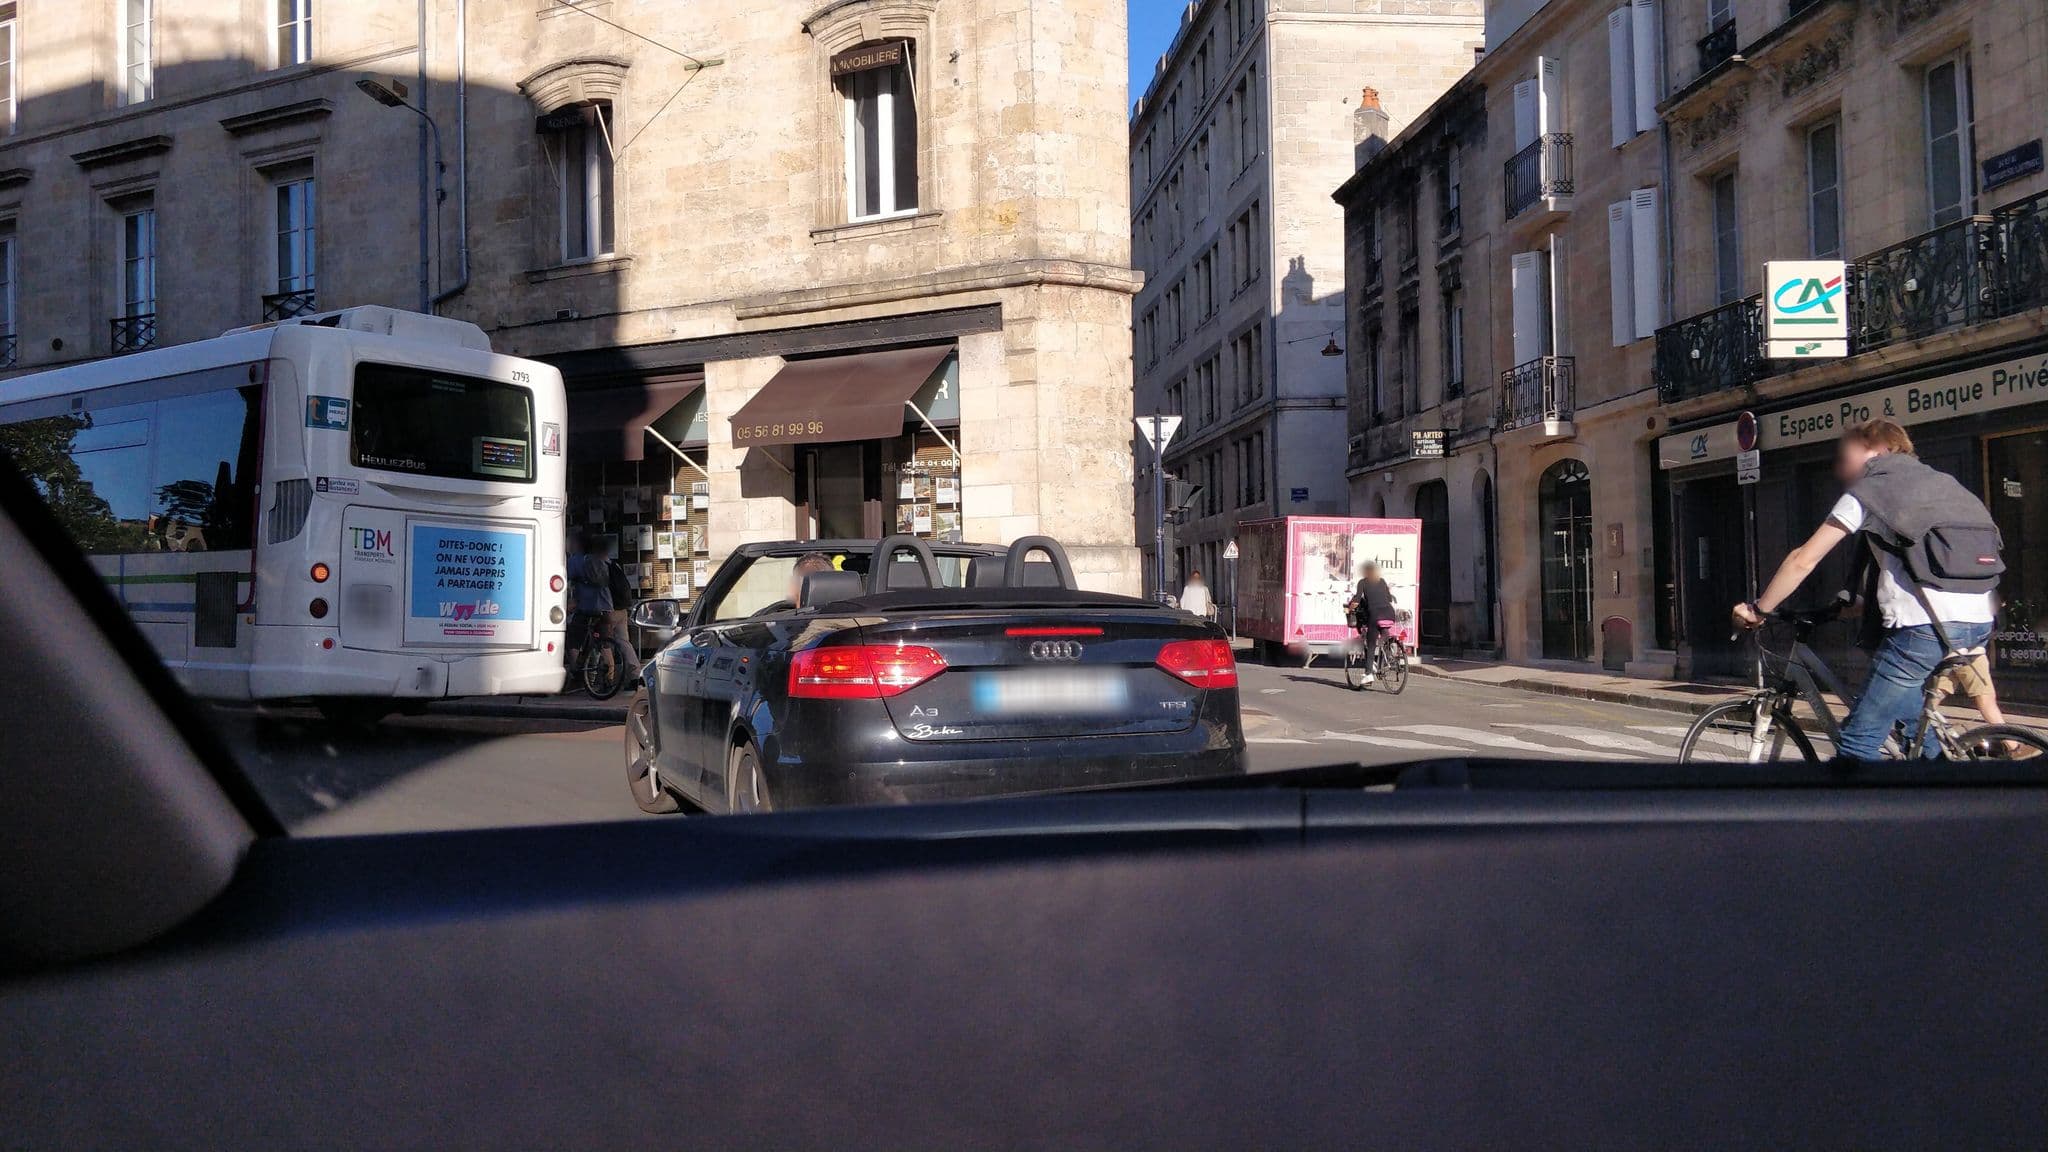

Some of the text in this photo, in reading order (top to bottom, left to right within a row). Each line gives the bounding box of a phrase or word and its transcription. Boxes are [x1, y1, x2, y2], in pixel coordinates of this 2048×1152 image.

[511, 371, 530, 383] 2793
[1780, 412, 1834, 440] Espace
[1840, 402, 1870, 425] Pro
[1883, 397, 1896, 417] &
[1908, 381, 1983, 413] Banque
[737, 421, 824, 440] 05 56 81 99 96
[349, 526, 394, 556] TBM
[439, 539, 497, 552] DITES-DONC
[436, 553, 505, 566] ON NE VOUS A
[435, 566, 506, 578] JAMAIS APPRIS
[447, 579, 495, 590] PARTAGER
[497, 581, 503, 590] ?
[439, 599, 500, 621] Wyylde
[909, 704, 939, 717] A3
